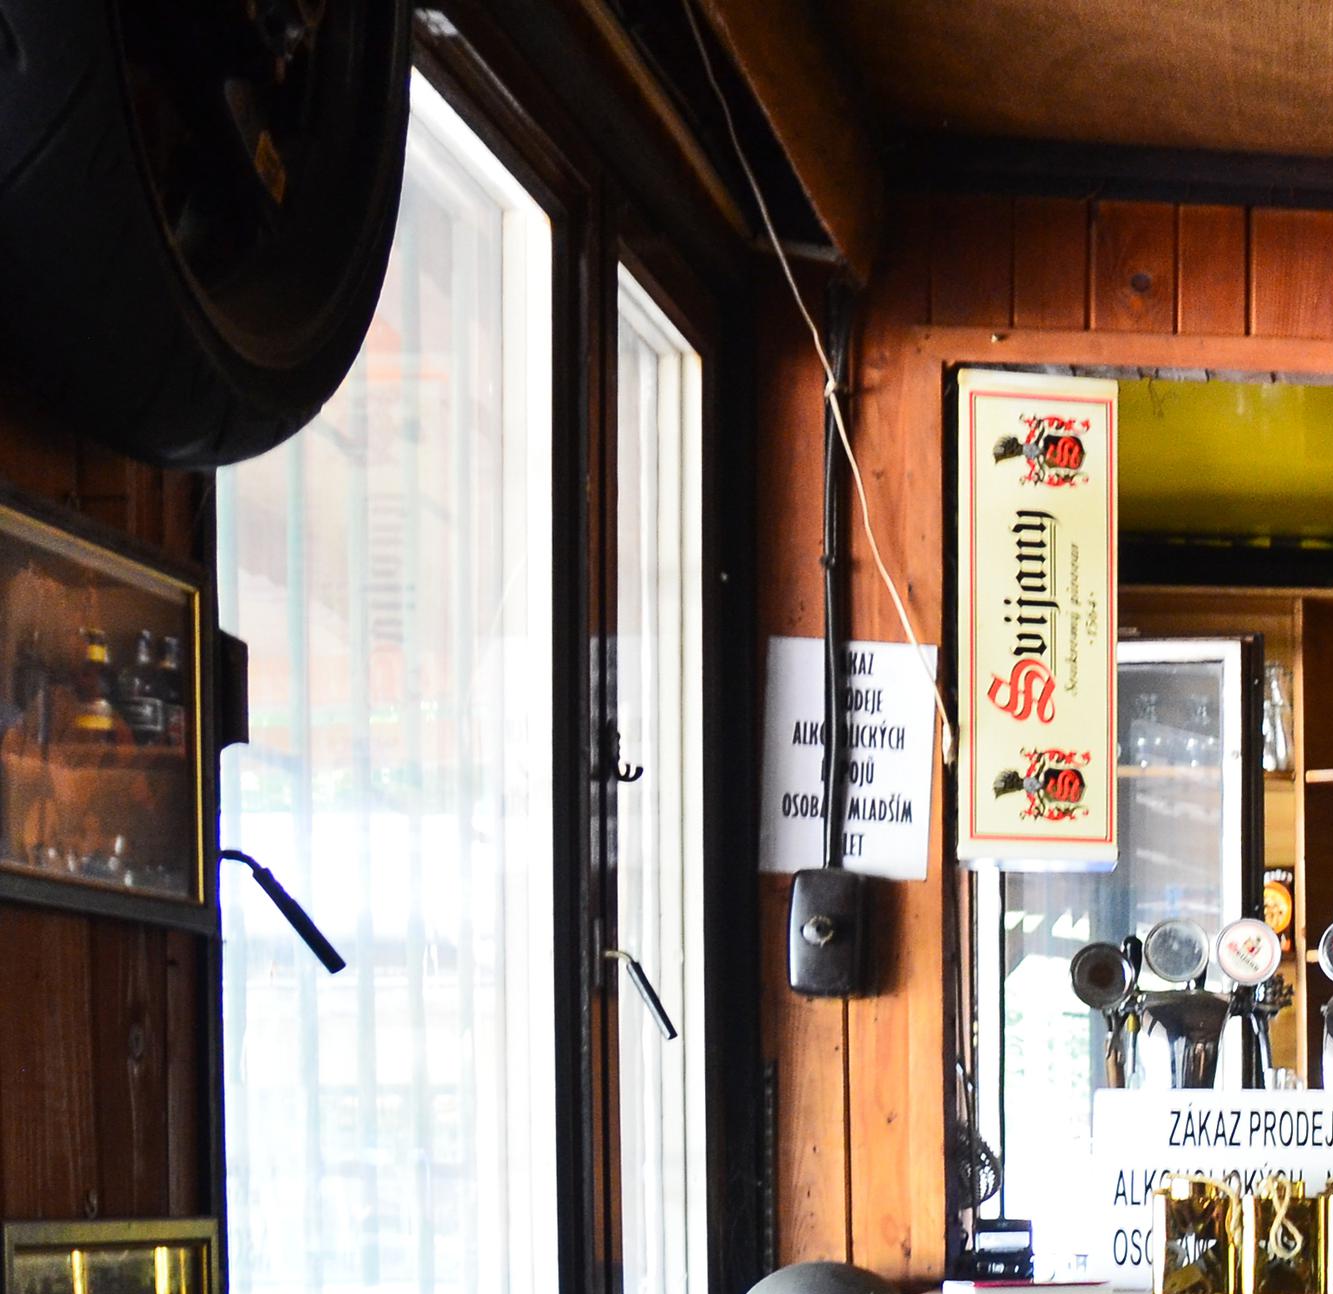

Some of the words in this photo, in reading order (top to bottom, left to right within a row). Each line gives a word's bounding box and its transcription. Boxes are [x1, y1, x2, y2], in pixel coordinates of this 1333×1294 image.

[986, 509, 1061, 725] Svijany
[847, 793, 914, 824] MLADŠÍM
[1167, 1101, 1243, 1148] ZÁKAZ
